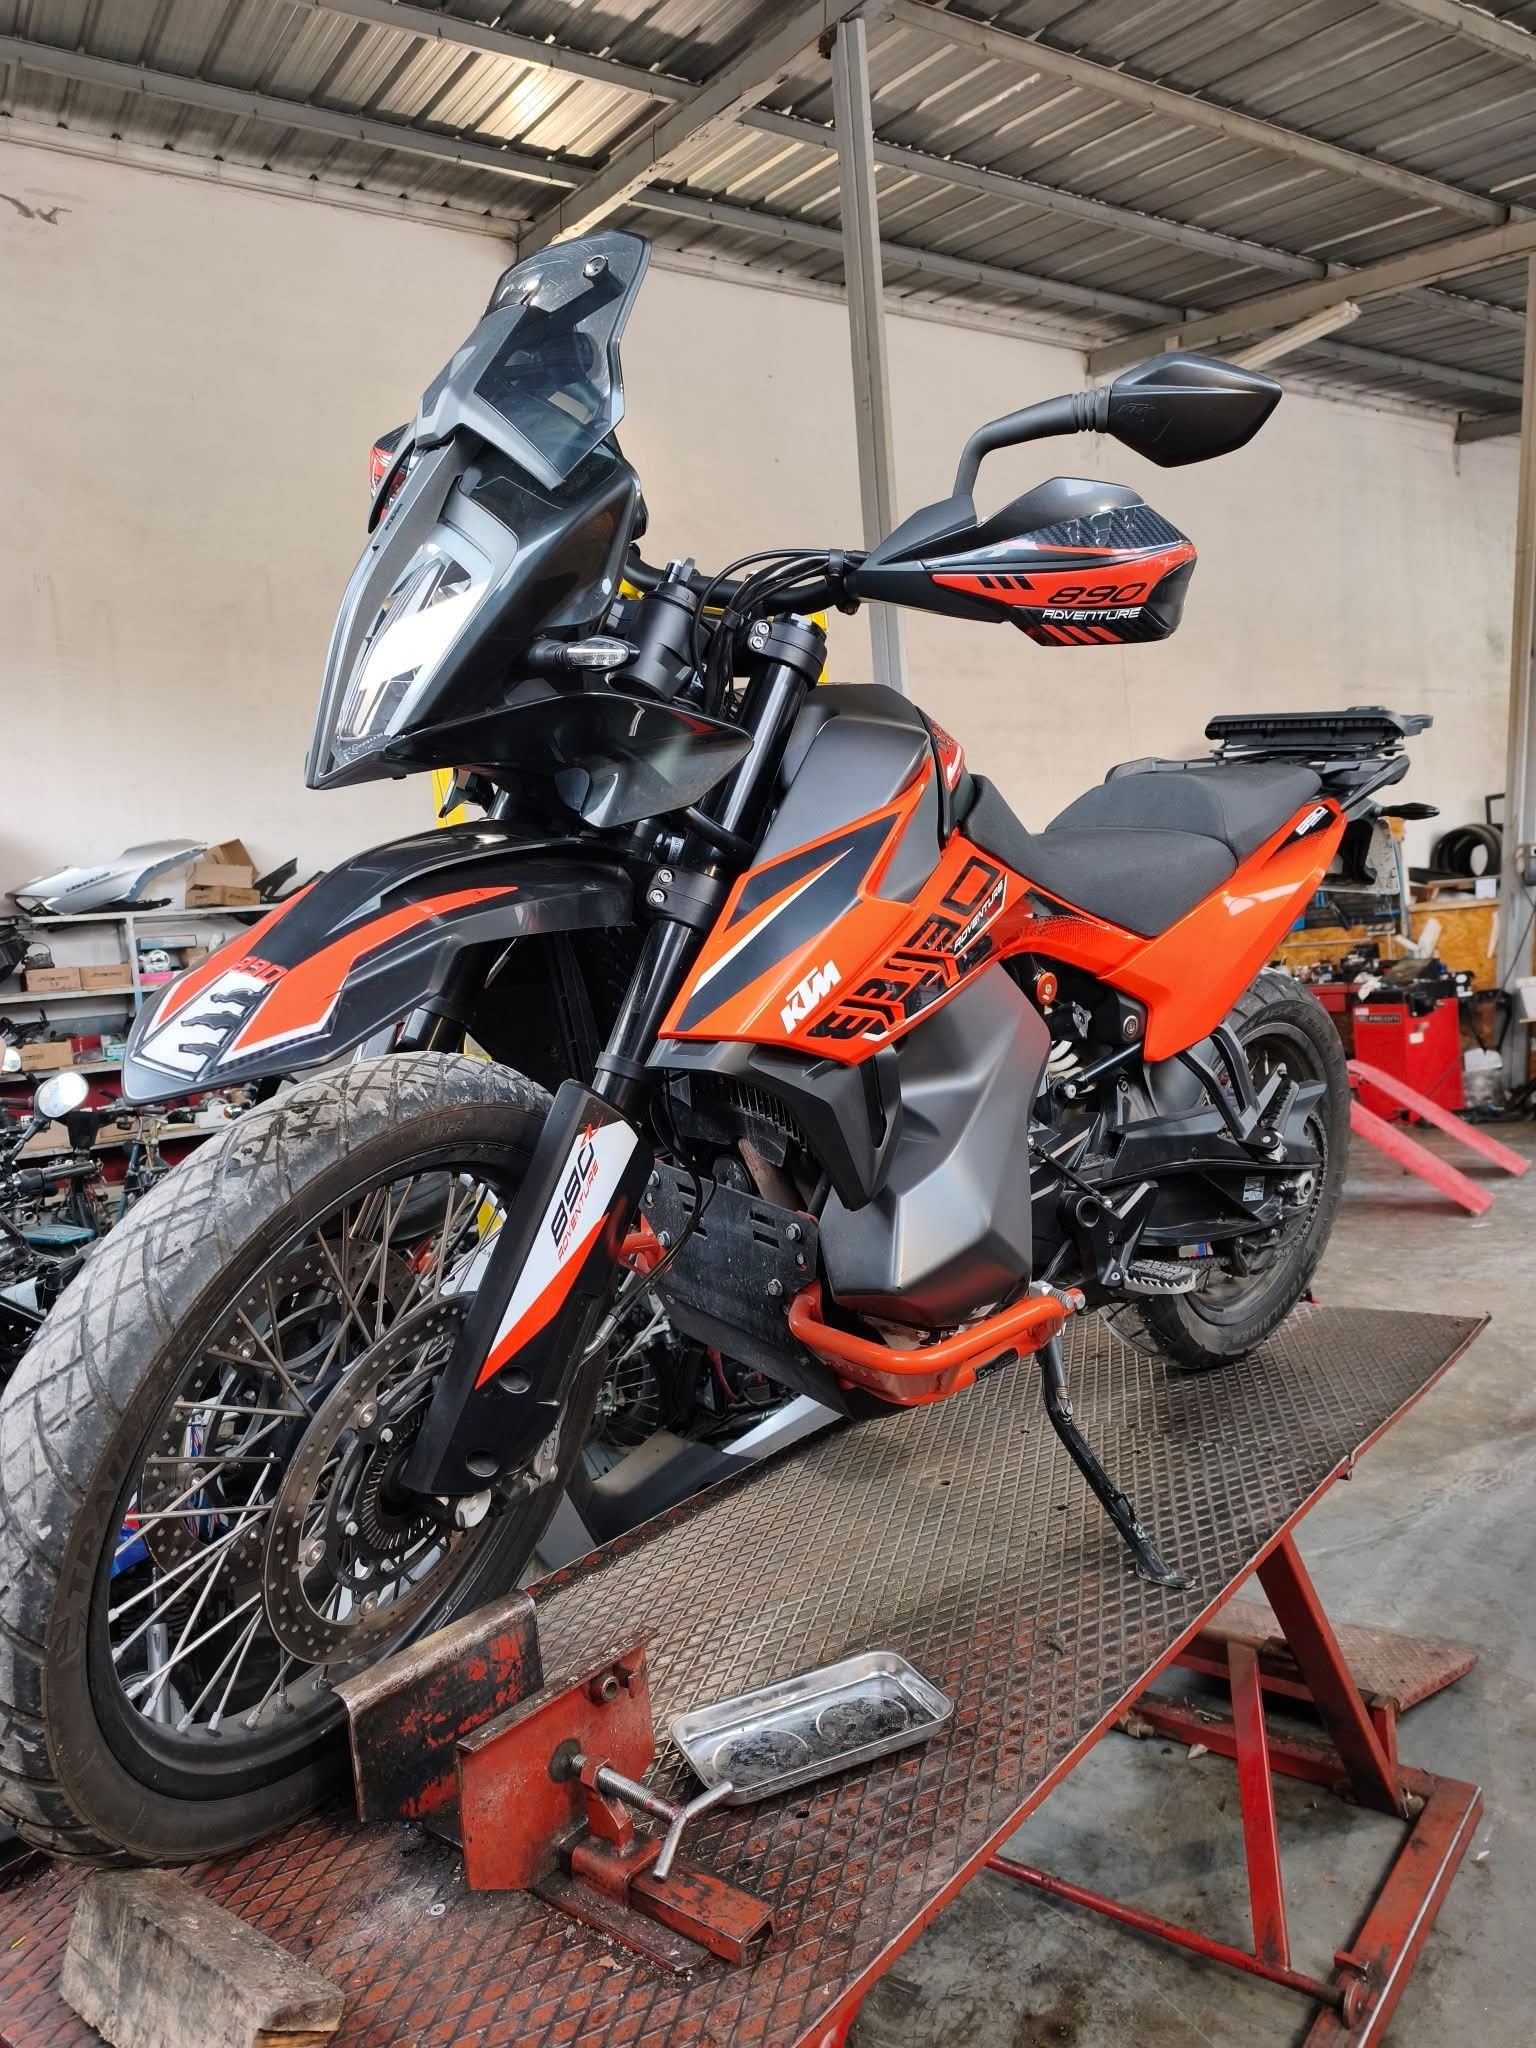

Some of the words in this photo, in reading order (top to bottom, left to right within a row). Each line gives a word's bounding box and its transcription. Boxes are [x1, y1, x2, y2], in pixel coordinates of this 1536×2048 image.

[1042, 607, 1141, 621] ADVENTURE
[1048, 582, 1148, 605] 890
[954, 879, 1004, 952] ADVENTURE
[780, 960, 842, 1034] KTM
[551, 1142, 594, 1247] 890
[557, 1159, 599, 1261] ADVENTURE
